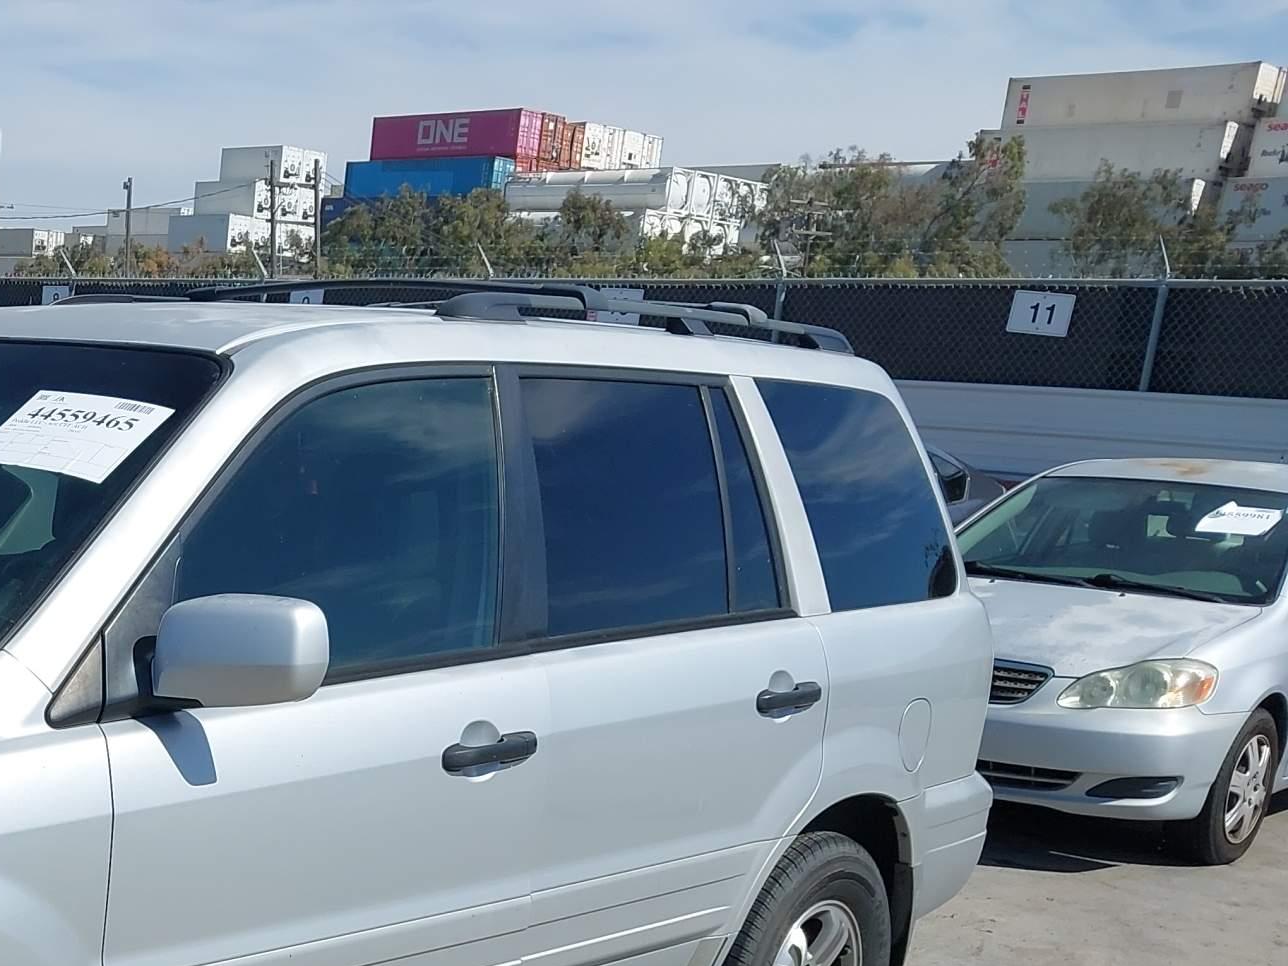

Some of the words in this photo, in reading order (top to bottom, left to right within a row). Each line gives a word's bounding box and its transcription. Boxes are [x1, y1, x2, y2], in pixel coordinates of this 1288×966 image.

[417, 118, 471, 145] ONE
[1030, 302, 1056, 325] 11
[27, 406, 140, 432] 44559465
